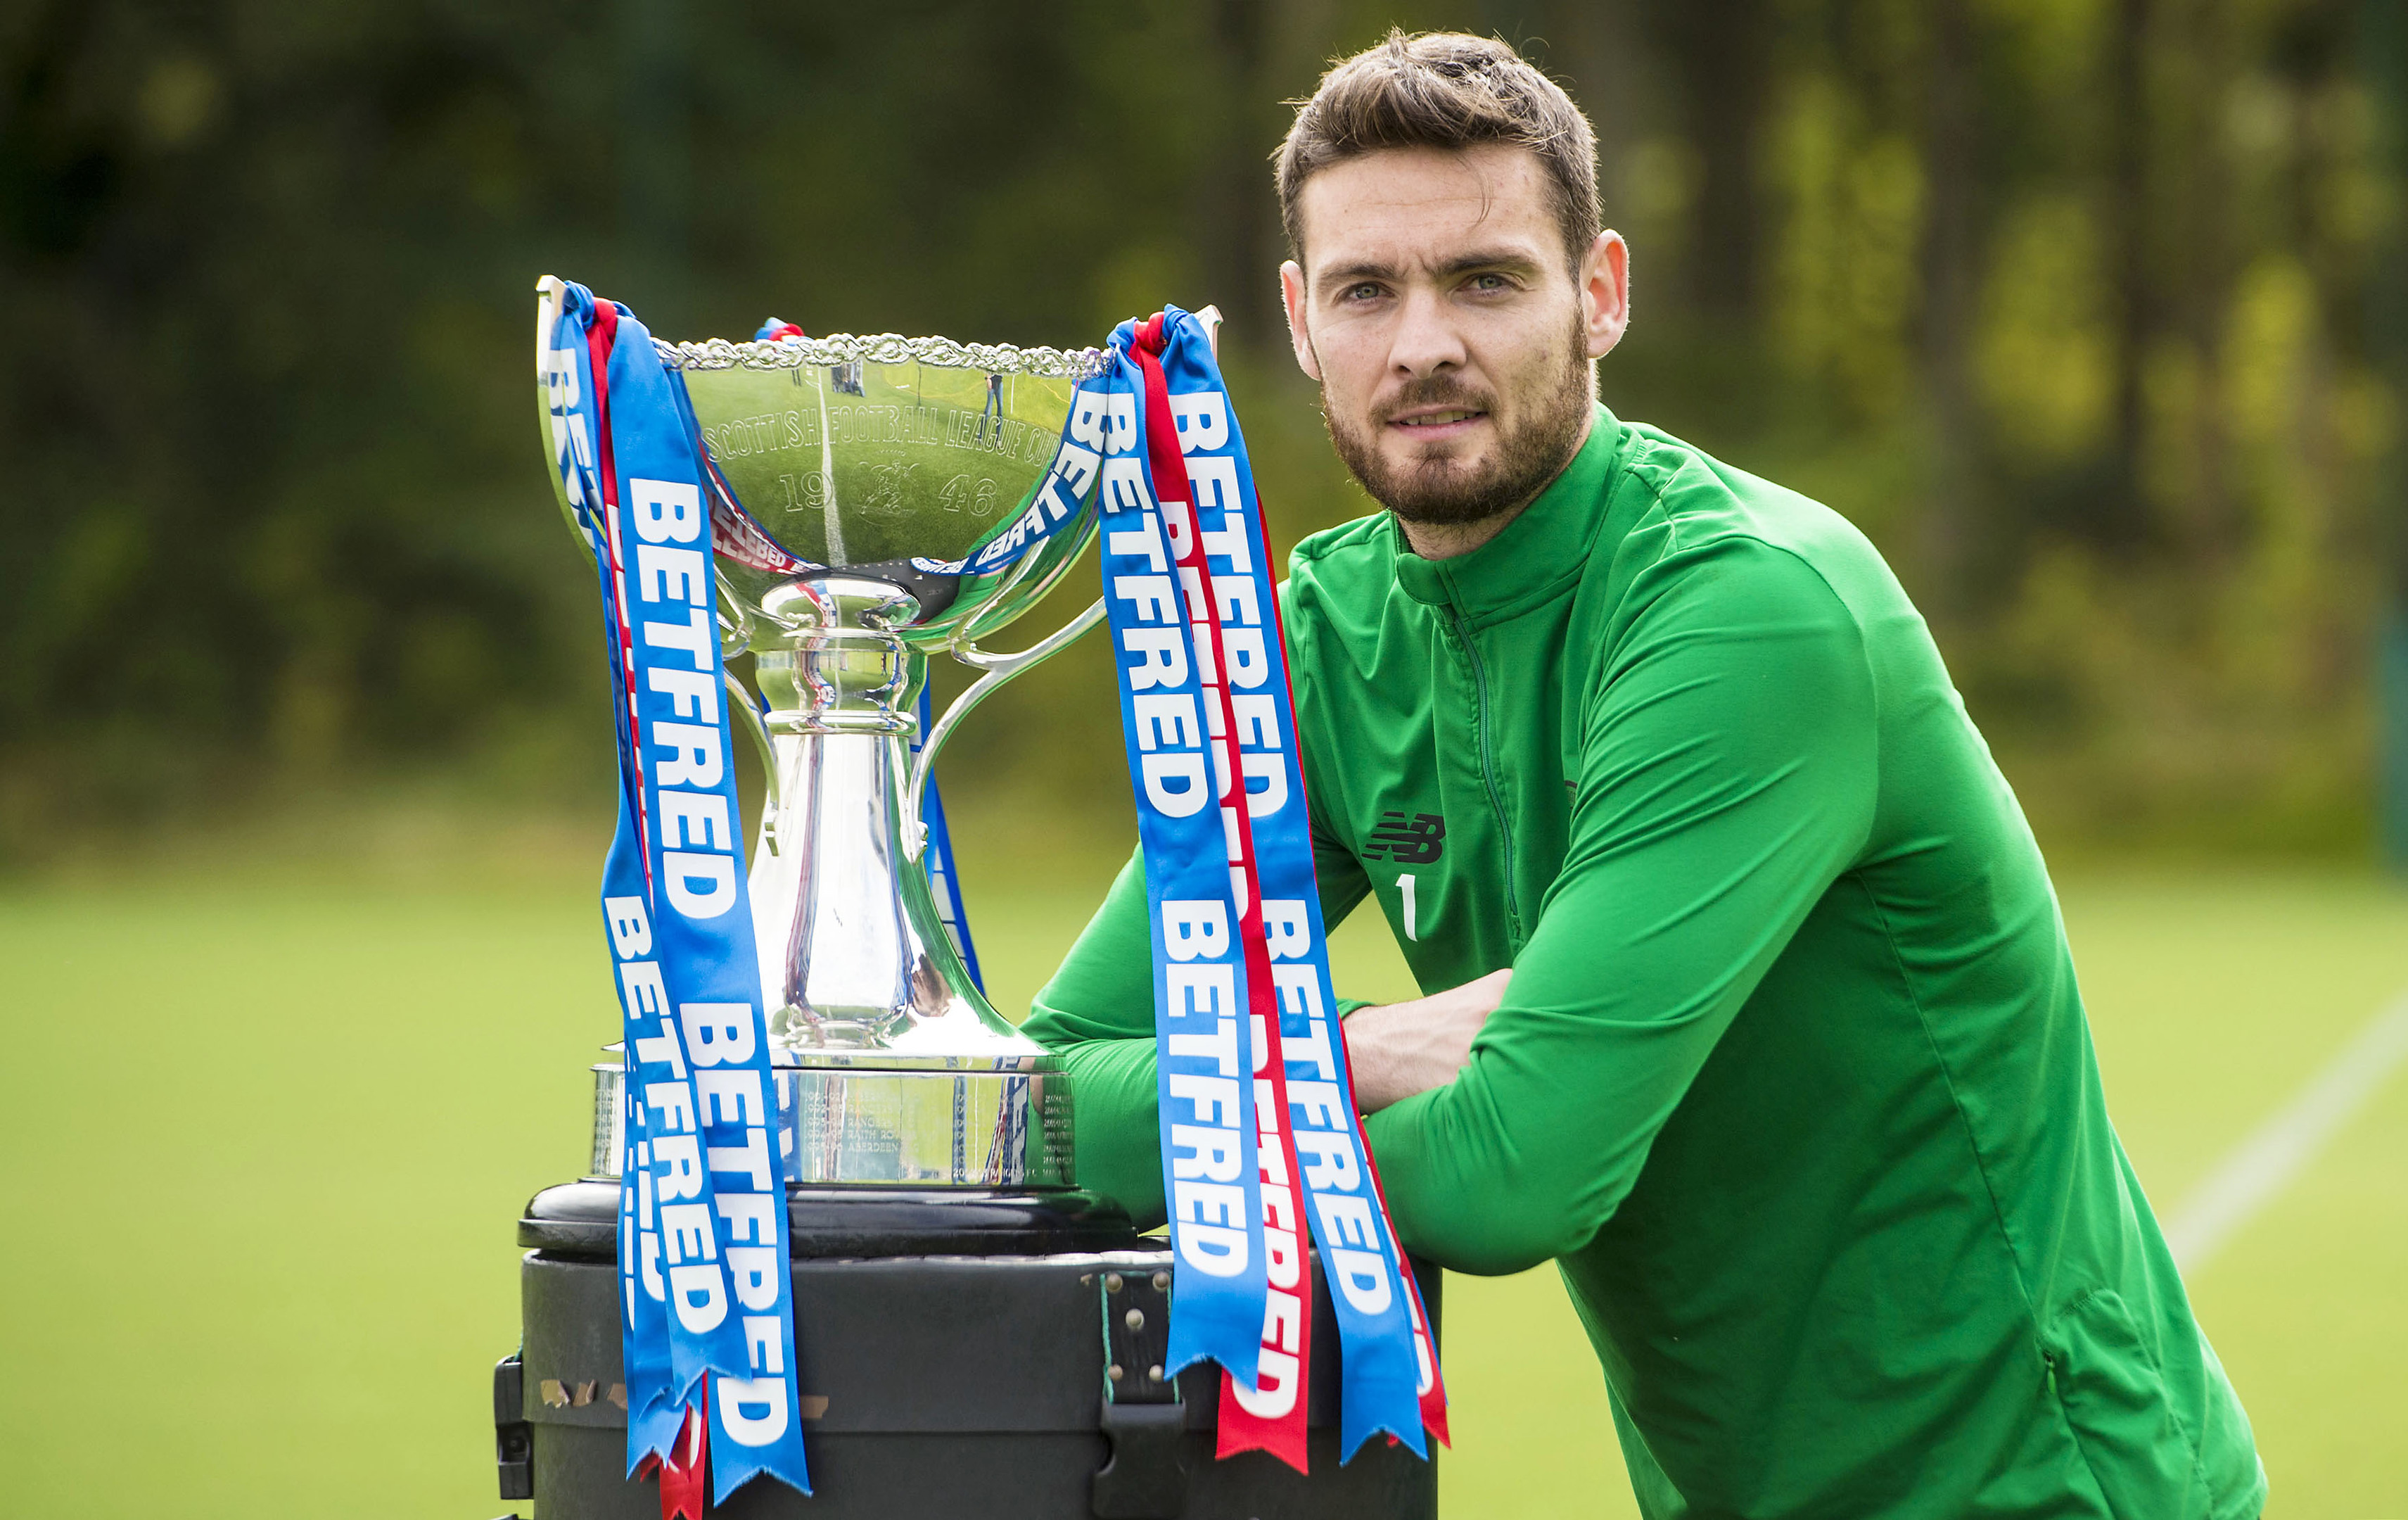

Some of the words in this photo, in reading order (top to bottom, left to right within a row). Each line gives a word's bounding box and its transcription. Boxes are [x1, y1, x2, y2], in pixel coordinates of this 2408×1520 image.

[702, 407, 822, 463] SCOTTISH
[827, 404, 938, 445] FOOTBALL
[944, 410, 1026, 459] LEAGUE
[1024, 427, 1061, 469] CUP
[779, 471, 834, 512] 19
[938, 474, 998, 517] 46
[1101, 393, 1209, 818] BETFRED
[1168, 391, 1289, 818] BETFRED
[629, 478, 737, 919] BETFRED
[1361, 811, 1446, 864] NB
[1161, 900, 1249, 1277] BETFRED
[1396, 873, 1418, 942] 1
[604, 896, 728, 1334] BETFRED
[680, 1003, 789, 1447] BETFRED
[847, 1141, 899, 1153] ABERDEEN
[1261, 899, 1392, 1316] BETFRED
